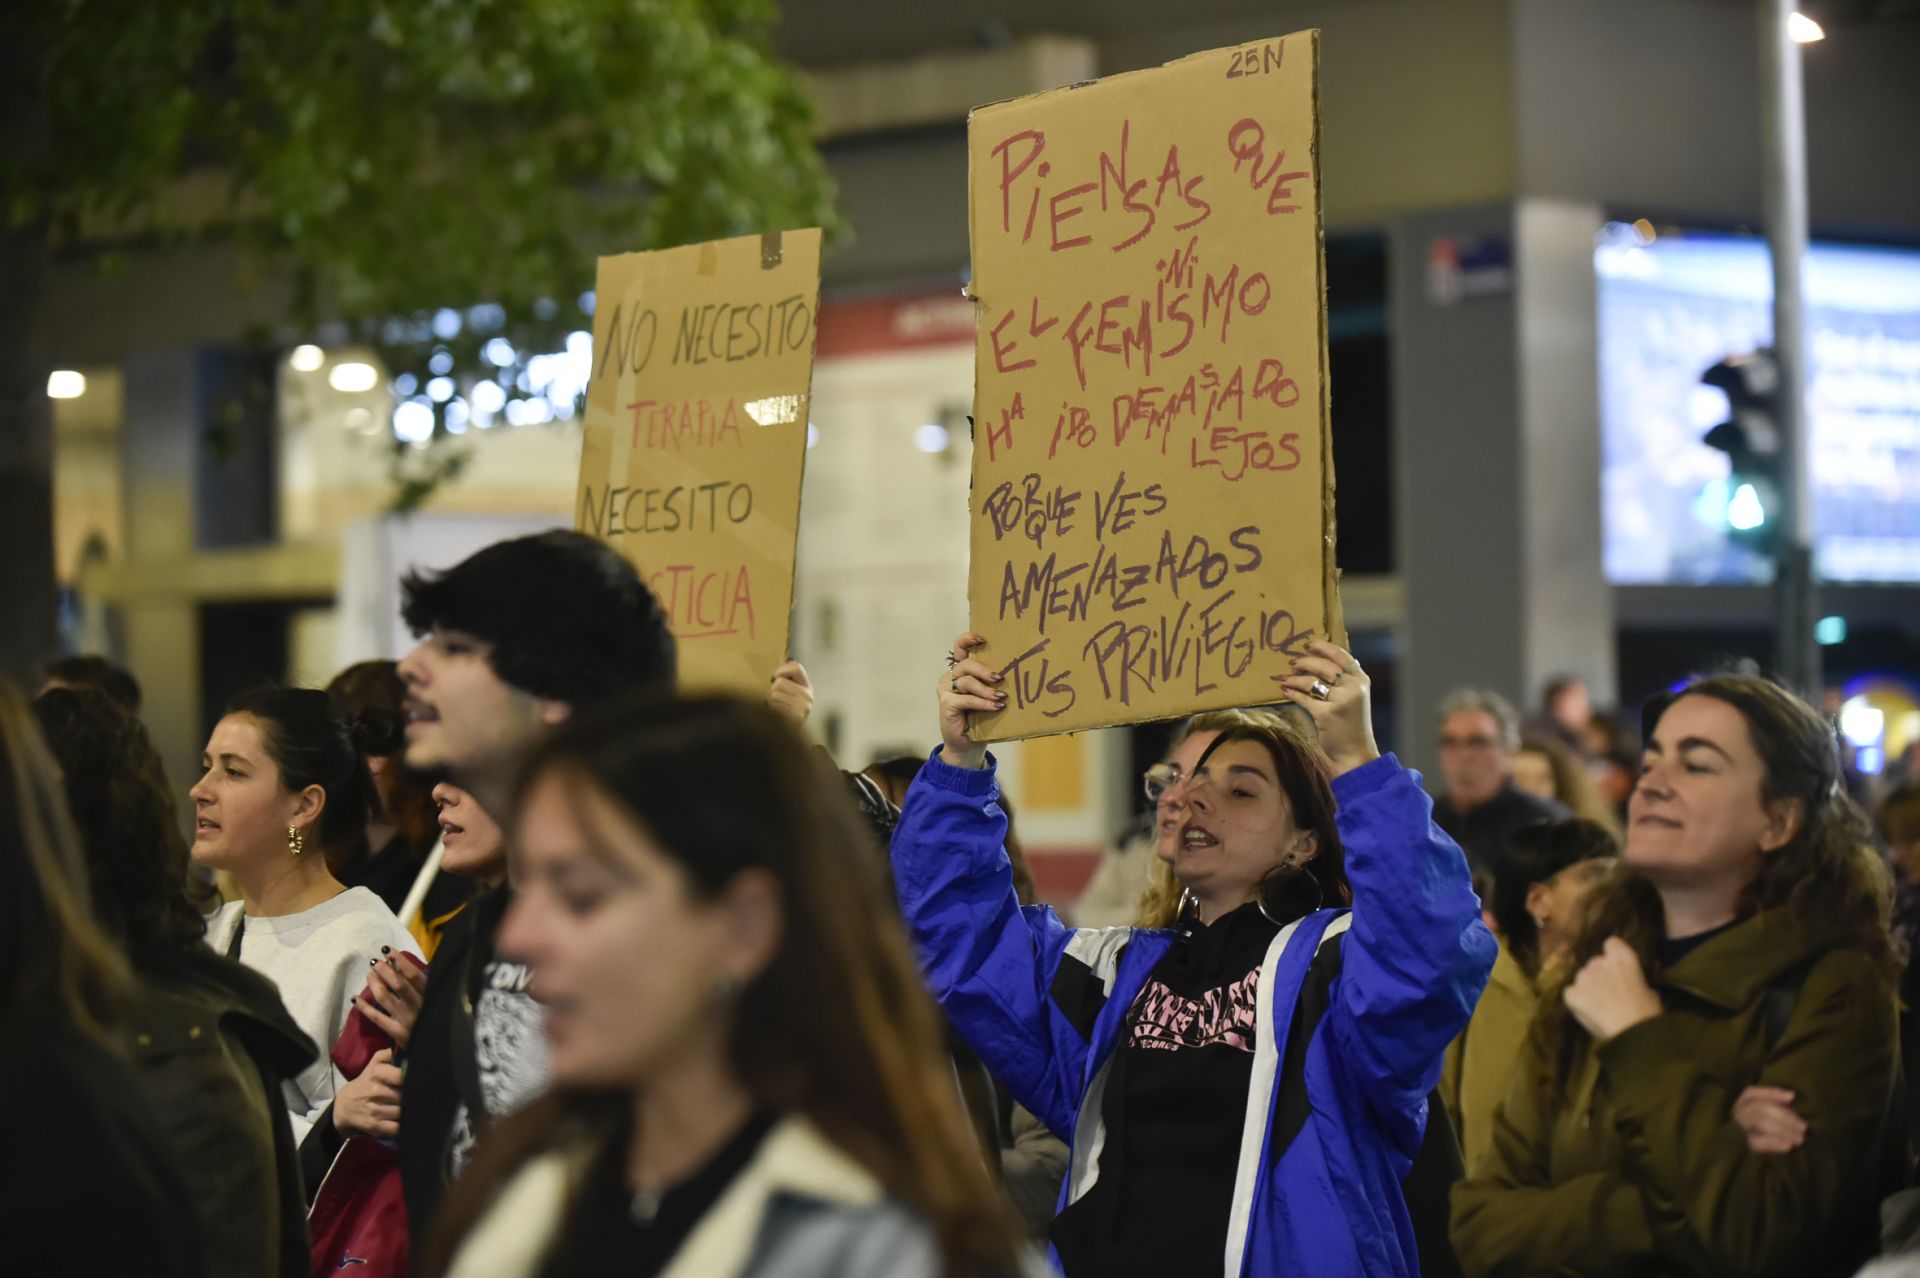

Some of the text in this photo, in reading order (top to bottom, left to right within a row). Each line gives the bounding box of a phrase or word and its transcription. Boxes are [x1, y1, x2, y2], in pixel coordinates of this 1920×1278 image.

[1225, 39, 1285, 79] 25N
[1228, 118, 1310, 215] QUE
[598, 301, 657, 379] NO
[672, 294, 811, 365] NECESITO
[991, 297, 1059, 373] EL
[626, 397, 743, 450] TERAPIA
[986, 392, 1025, 463] HA
[1191, 427, 1301, 481] LEJOS
[581, 480, 753, 537] NECESITO
[1094, 471, 1168, 541] VES
[650, 564, 756, 640] STICIA
[1000, 526, 1262, 634] AMENAZADOS
[1000, 638, 1075, 717] TUS
